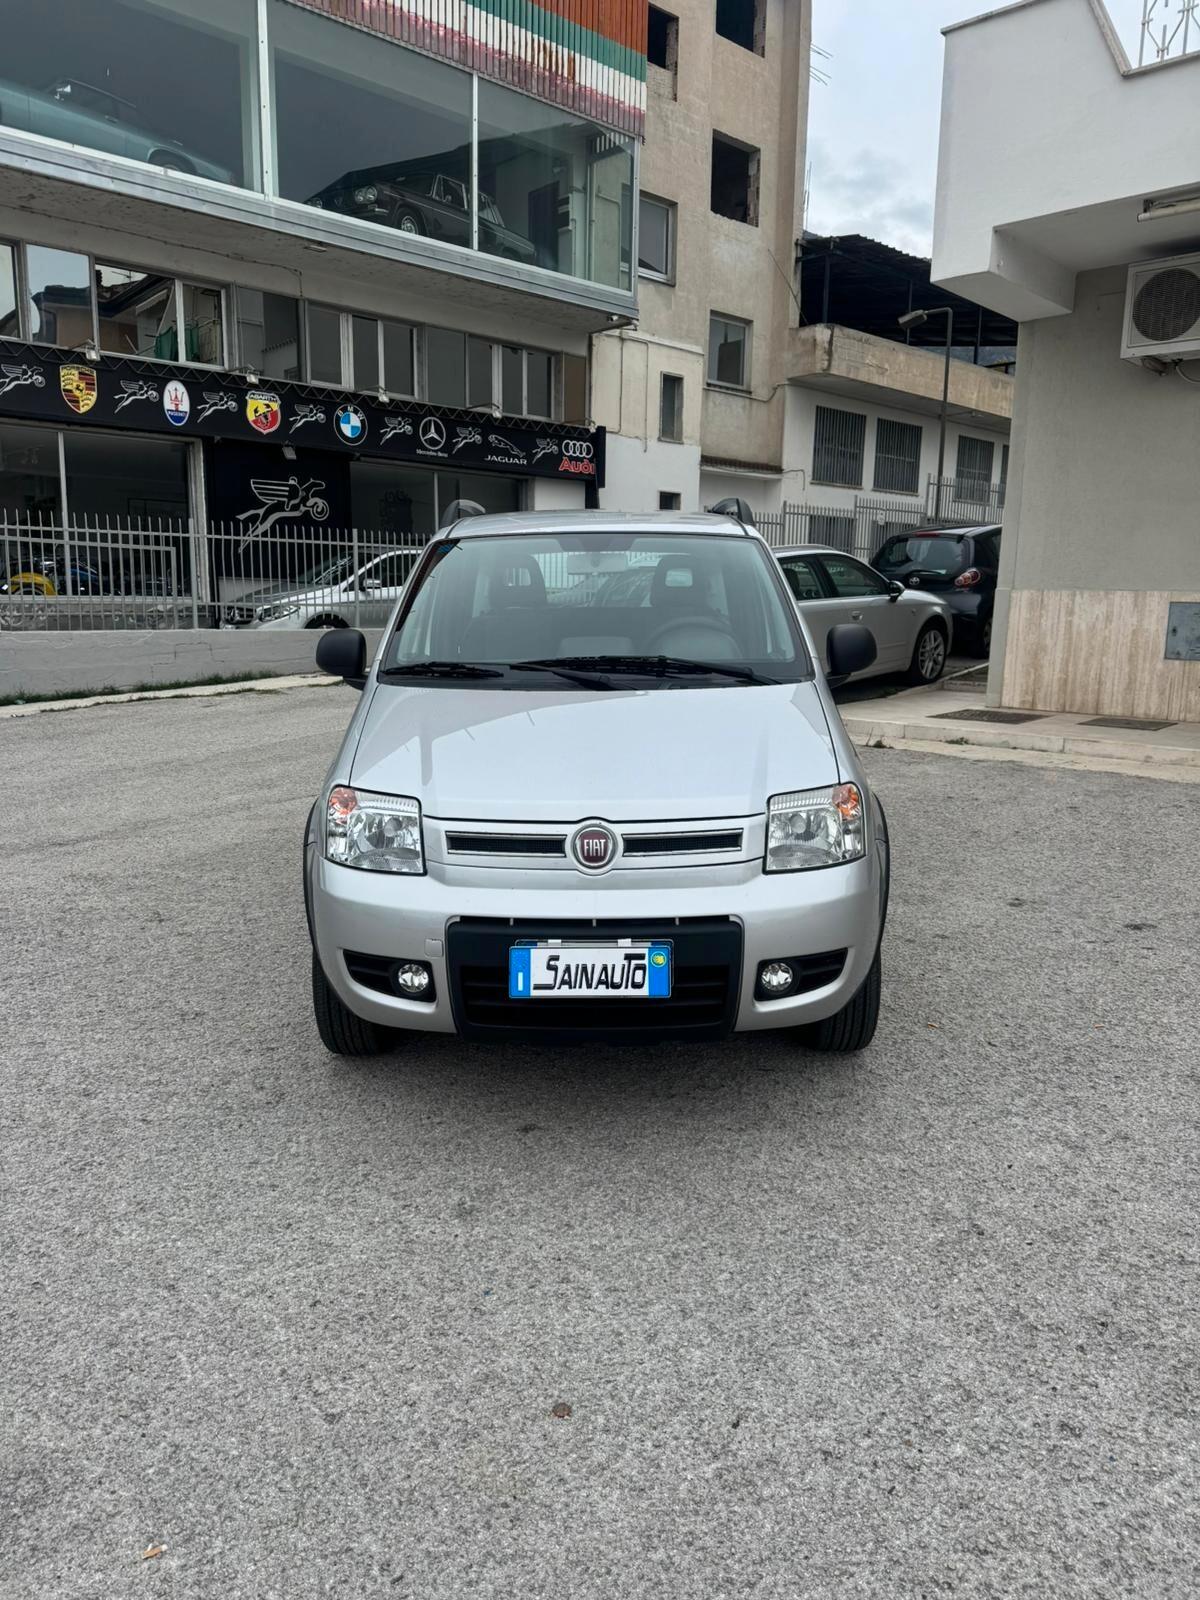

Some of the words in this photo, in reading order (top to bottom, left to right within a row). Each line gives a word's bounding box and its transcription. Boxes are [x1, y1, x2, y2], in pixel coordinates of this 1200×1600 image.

[337, 405, 365, 420] BMW
[484, 454, 528, 465] JAGUAR
[558, 456, 596, 475] Audi
[584, 839, 606, 856] FIAT
